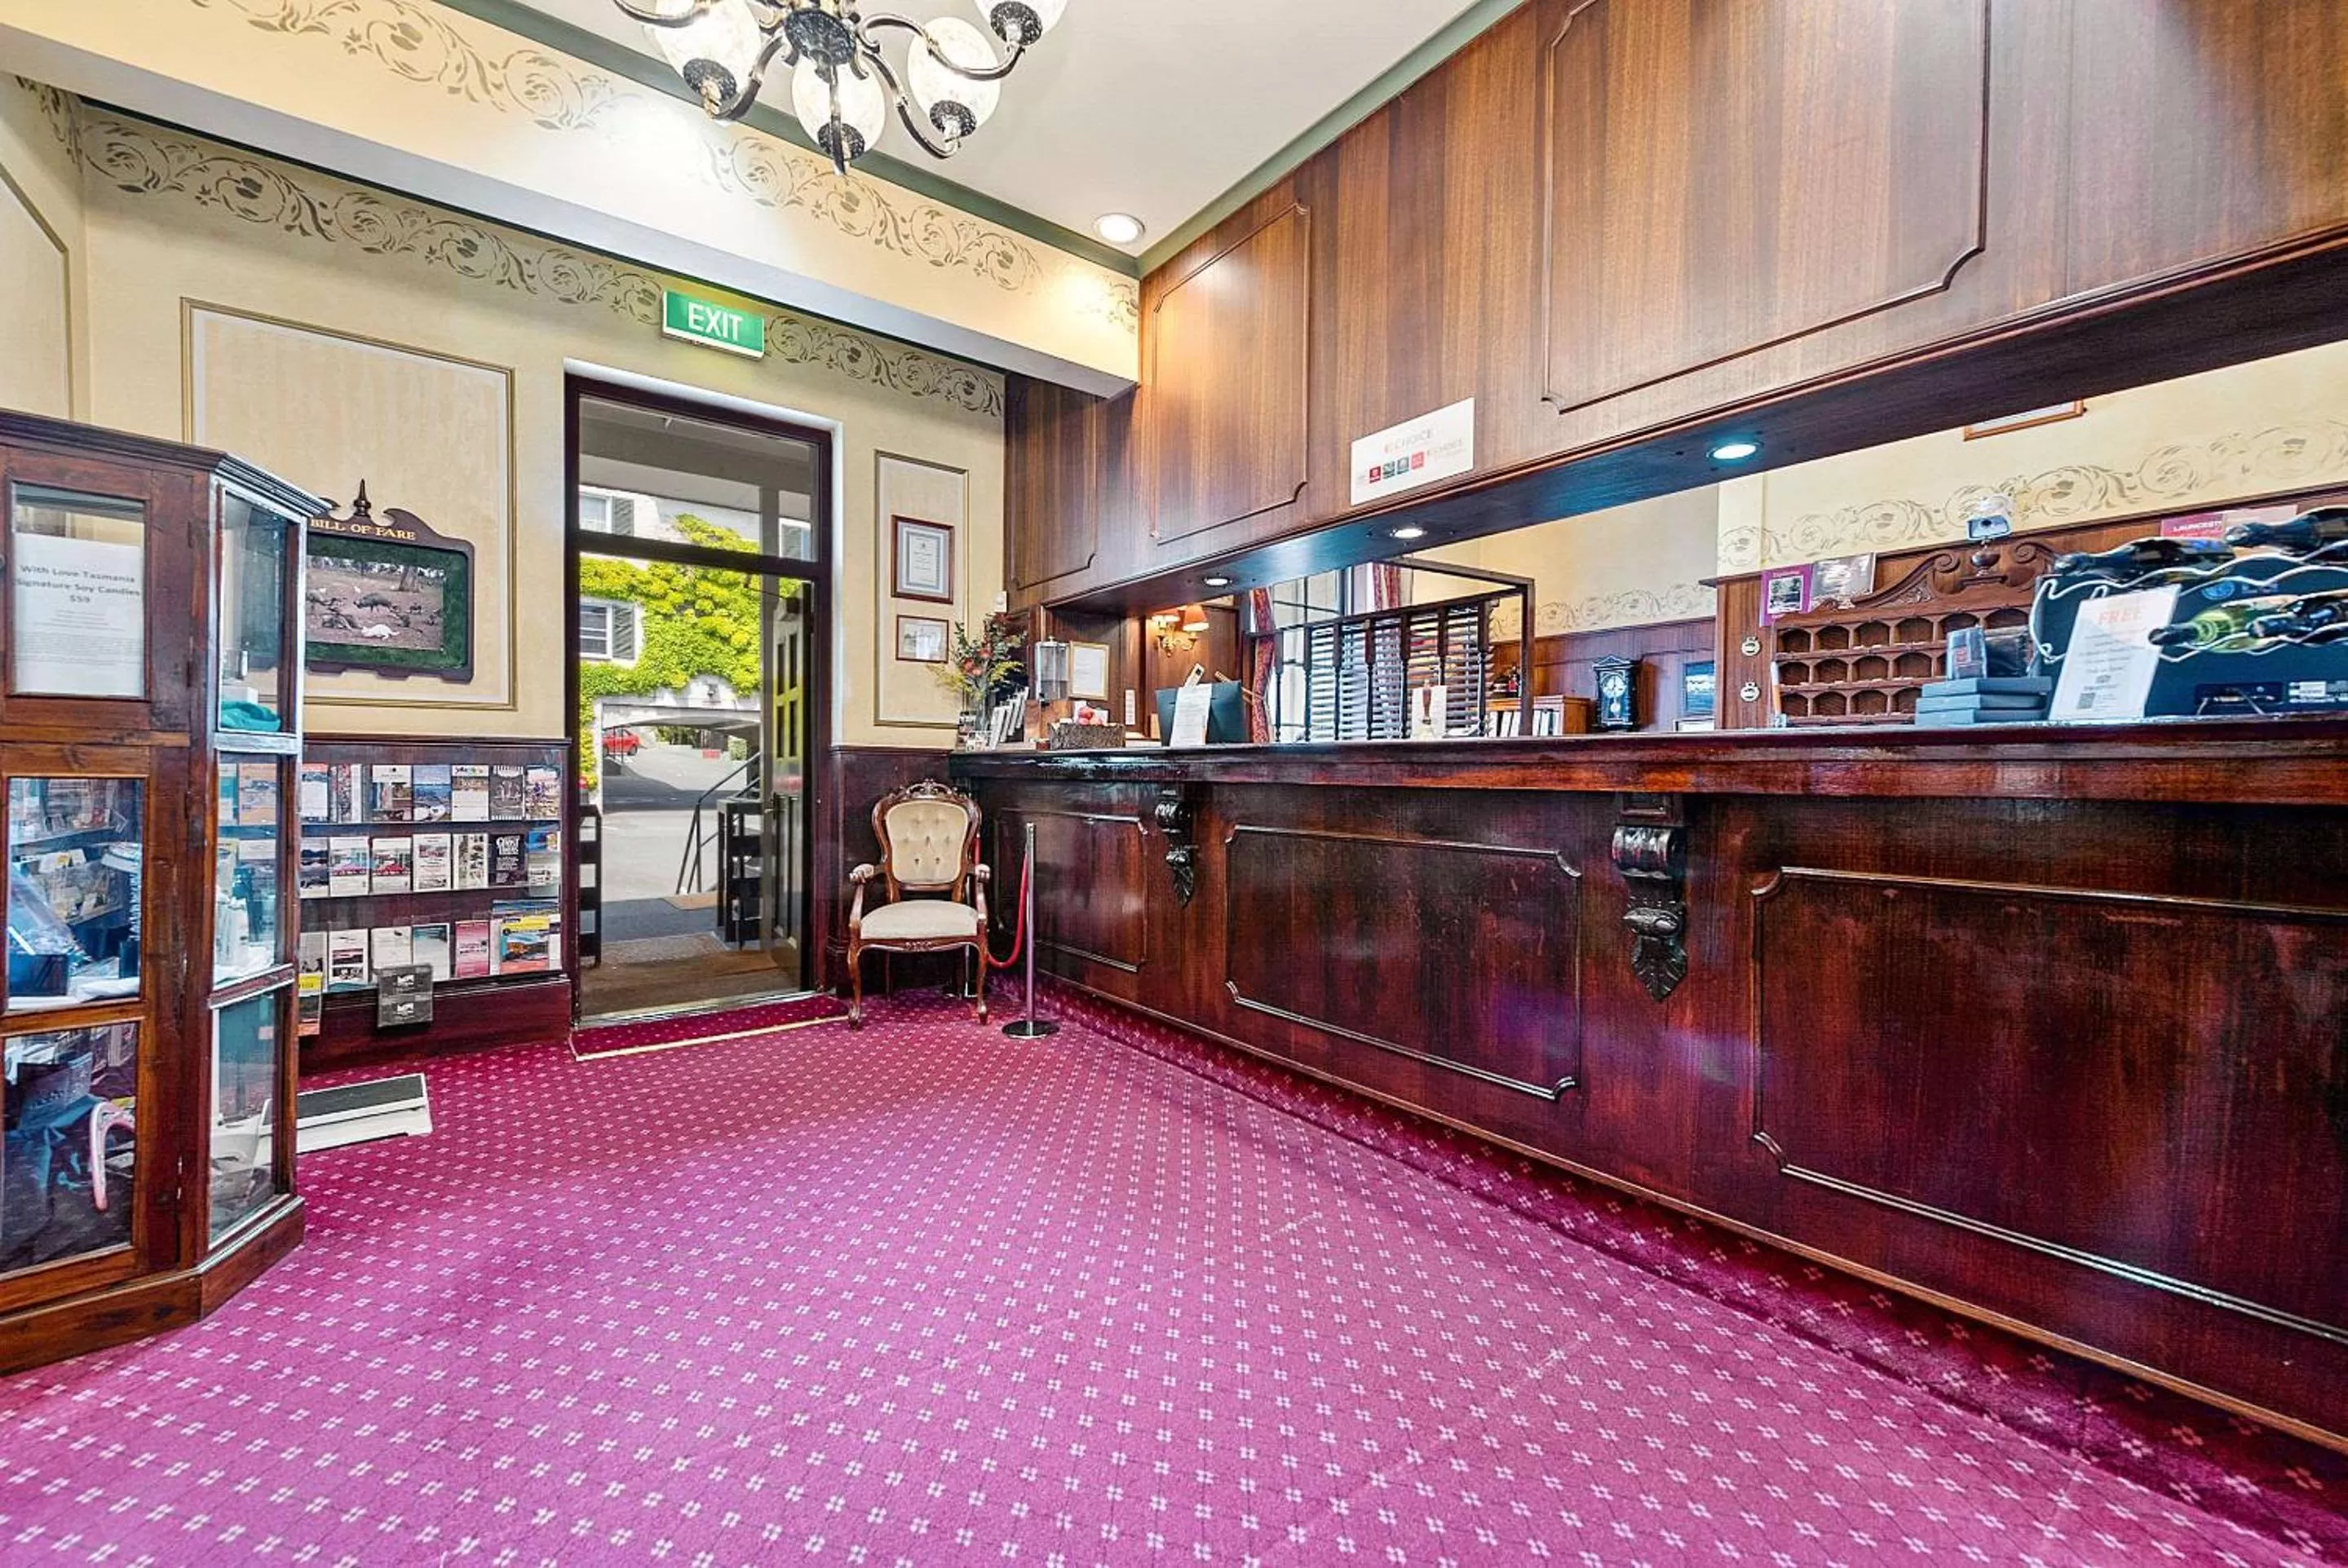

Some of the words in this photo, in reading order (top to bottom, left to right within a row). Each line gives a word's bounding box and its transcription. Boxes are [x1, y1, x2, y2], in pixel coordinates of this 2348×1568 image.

[688, 301, 744, 342] EXIT
[310, 519, 345, 532] BILL
[350, 523, 372, 535] OF
[375, 527, 417, 541] FARE
[20, 564, 50, 575] With
[51, 568, 79, 577] Love
[82, 571, 135, 583] Tasmania
[74, 584, 95, 594] Soy
[98, 586, 140, 596] Candles
